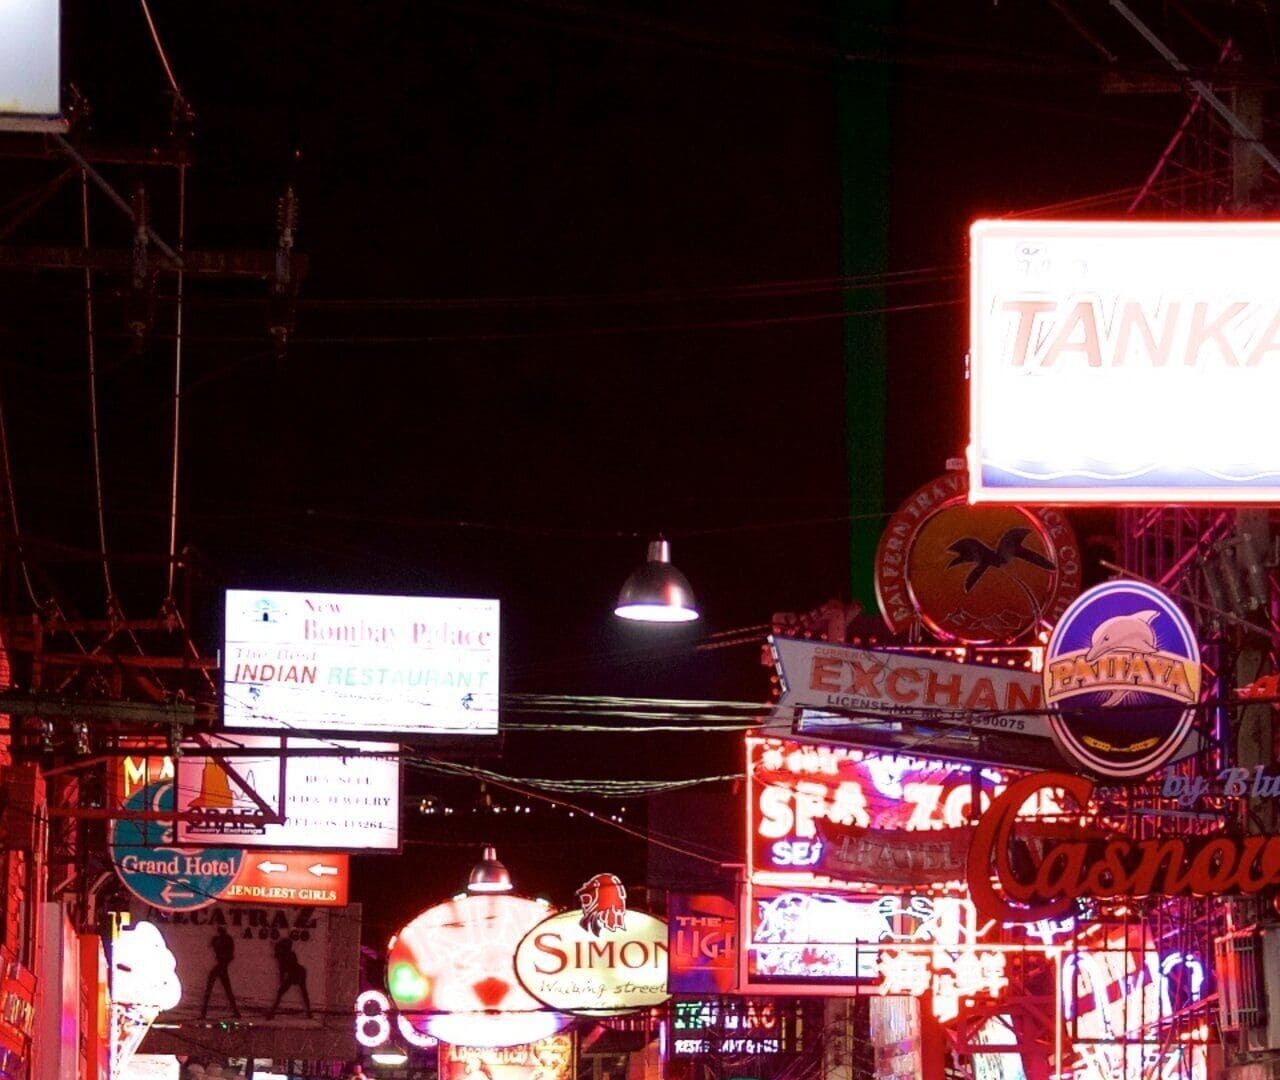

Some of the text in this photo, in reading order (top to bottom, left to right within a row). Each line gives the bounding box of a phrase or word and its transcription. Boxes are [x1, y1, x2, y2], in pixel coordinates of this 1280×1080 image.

[233, 663, 489, 689] INDIAN RESTAURANT
[1049, 653, 1196, 704] PATTAYA
[121, 855, 238, 877] Grand Hotel
[298, 888, 337, 902] GIRLS
[675, 916, 726, 928] THE
[611, 980, 667, 995] street
